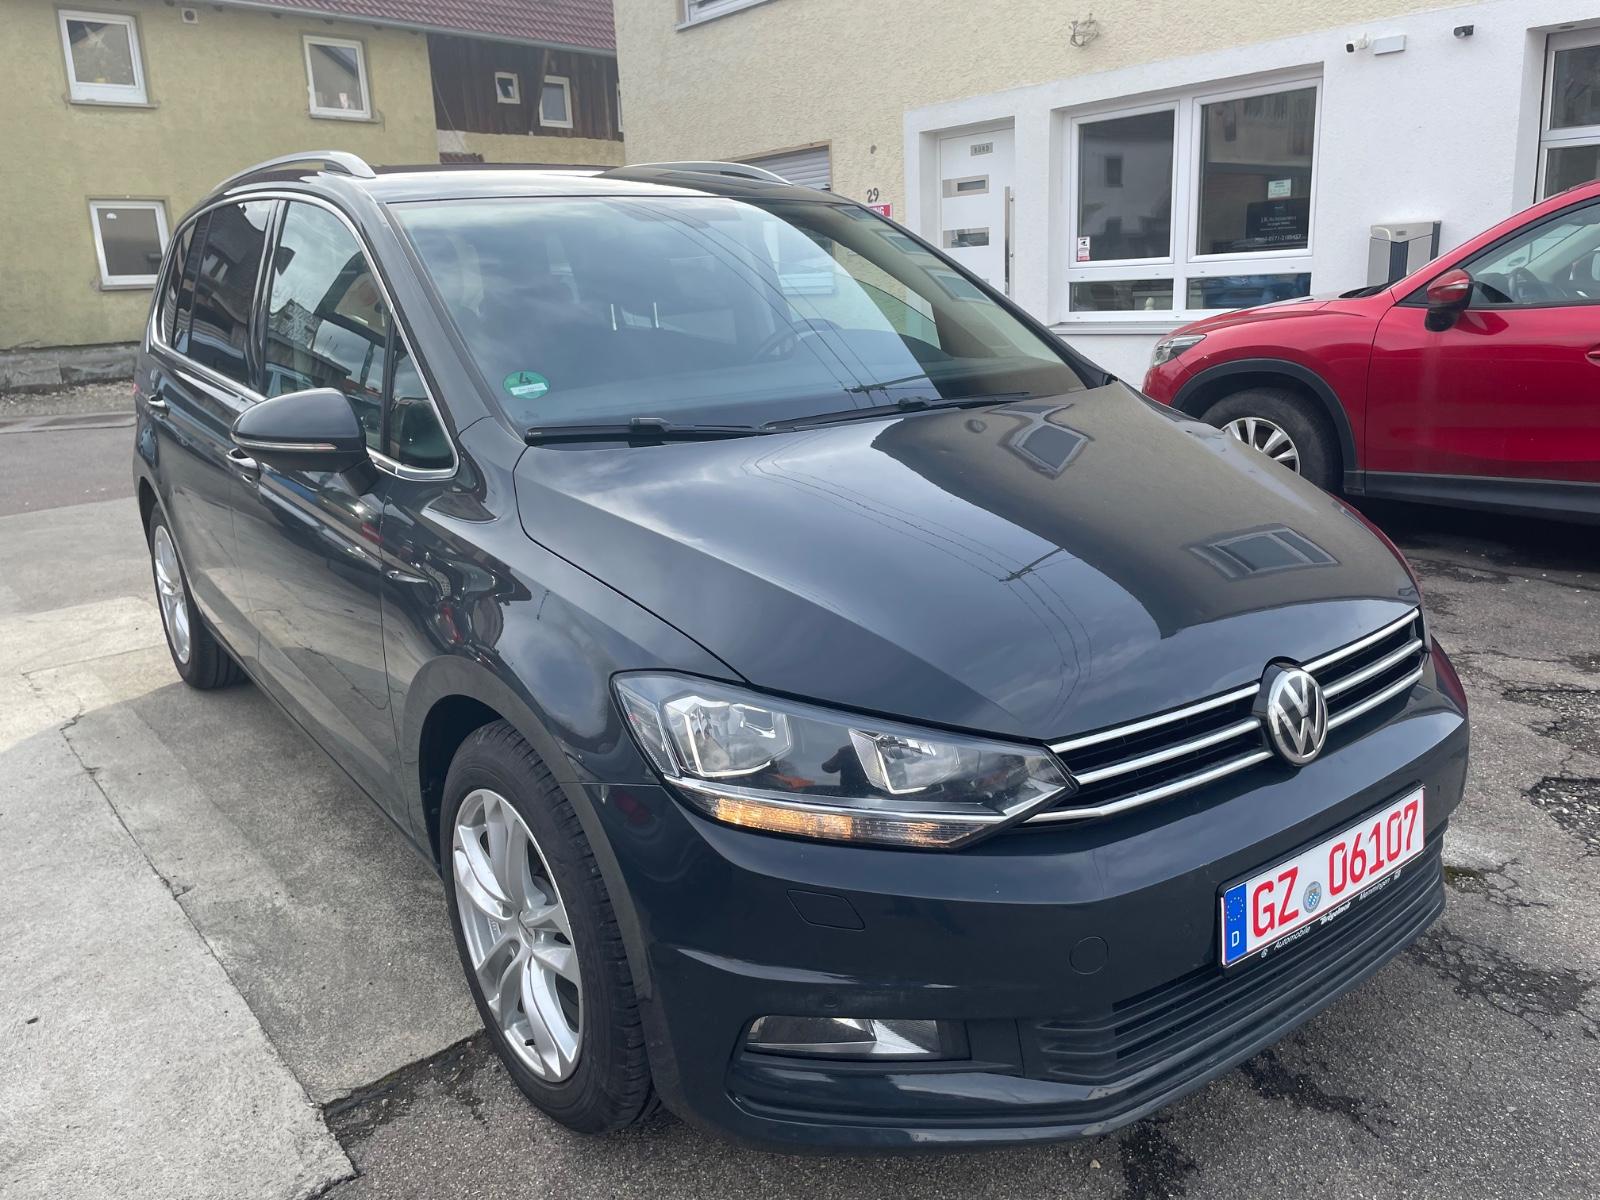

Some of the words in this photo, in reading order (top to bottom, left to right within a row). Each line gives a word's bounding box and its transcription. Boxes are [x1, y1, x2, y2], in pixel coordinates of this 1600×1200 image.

[866, 187, 879, 203] 29
[1252, 866, 1300, 938] GZ
[1328, 799, 1419, 897] 06107
[1231, 930, 1240, 948] D
